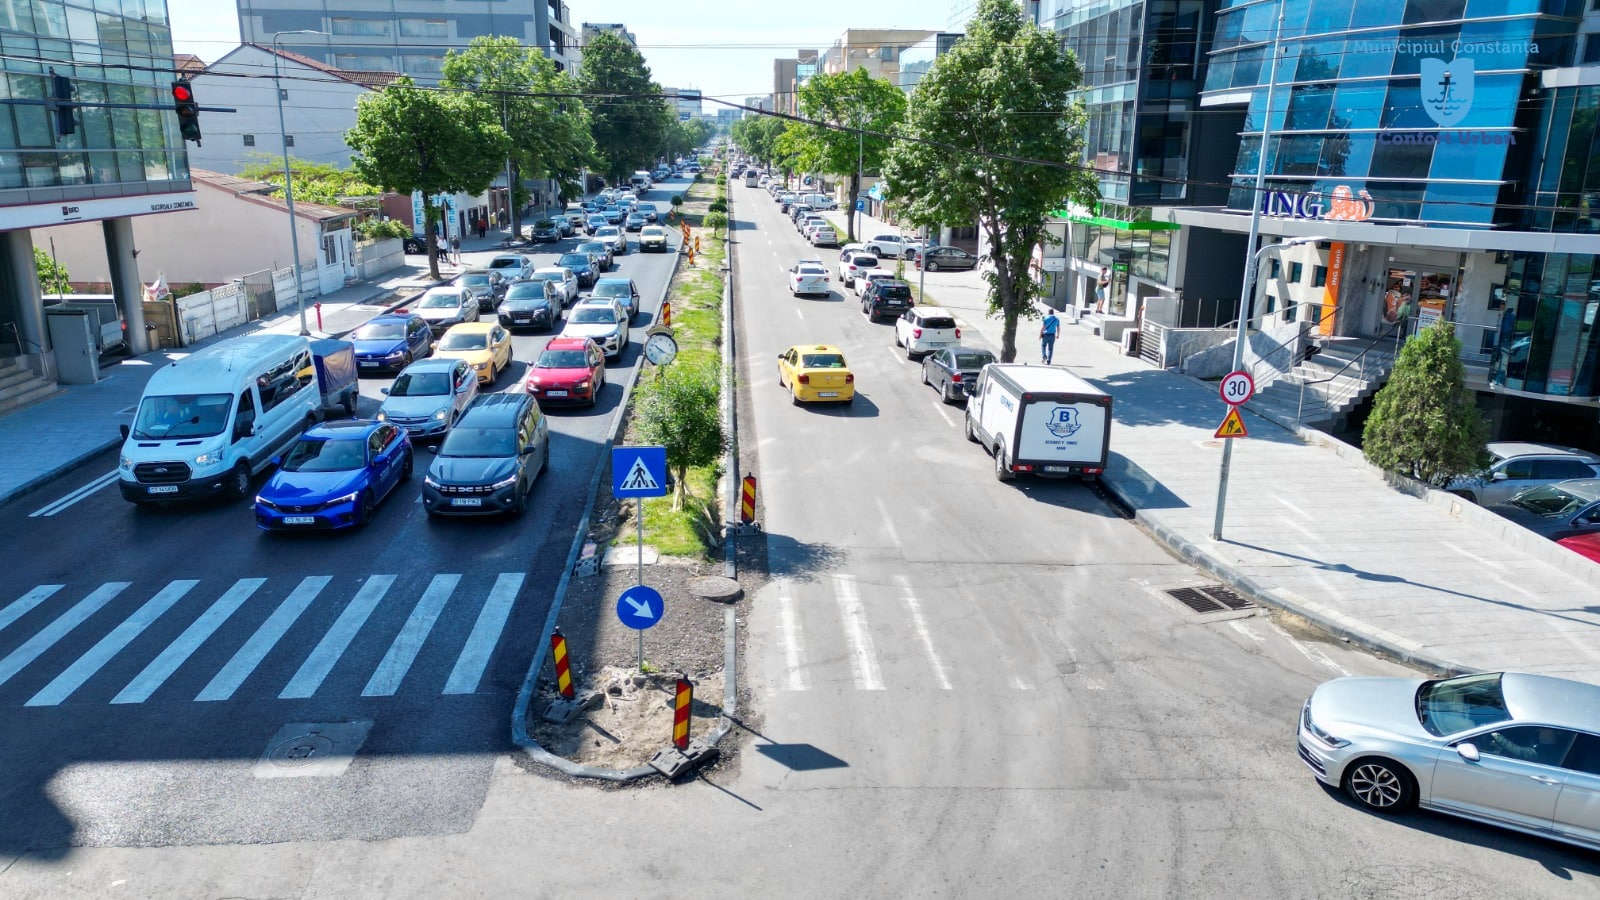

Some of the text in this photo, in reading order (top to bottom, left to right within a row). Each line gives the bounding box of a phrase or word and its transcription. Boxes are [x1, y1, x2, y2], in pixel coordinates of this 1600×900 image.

[1260, 190, 1324, 219] ING
[1333, 248, 1342, 268] Bank
[1228, 380, 1246, 396] 30
[1060, 411, 1070, 422] B
